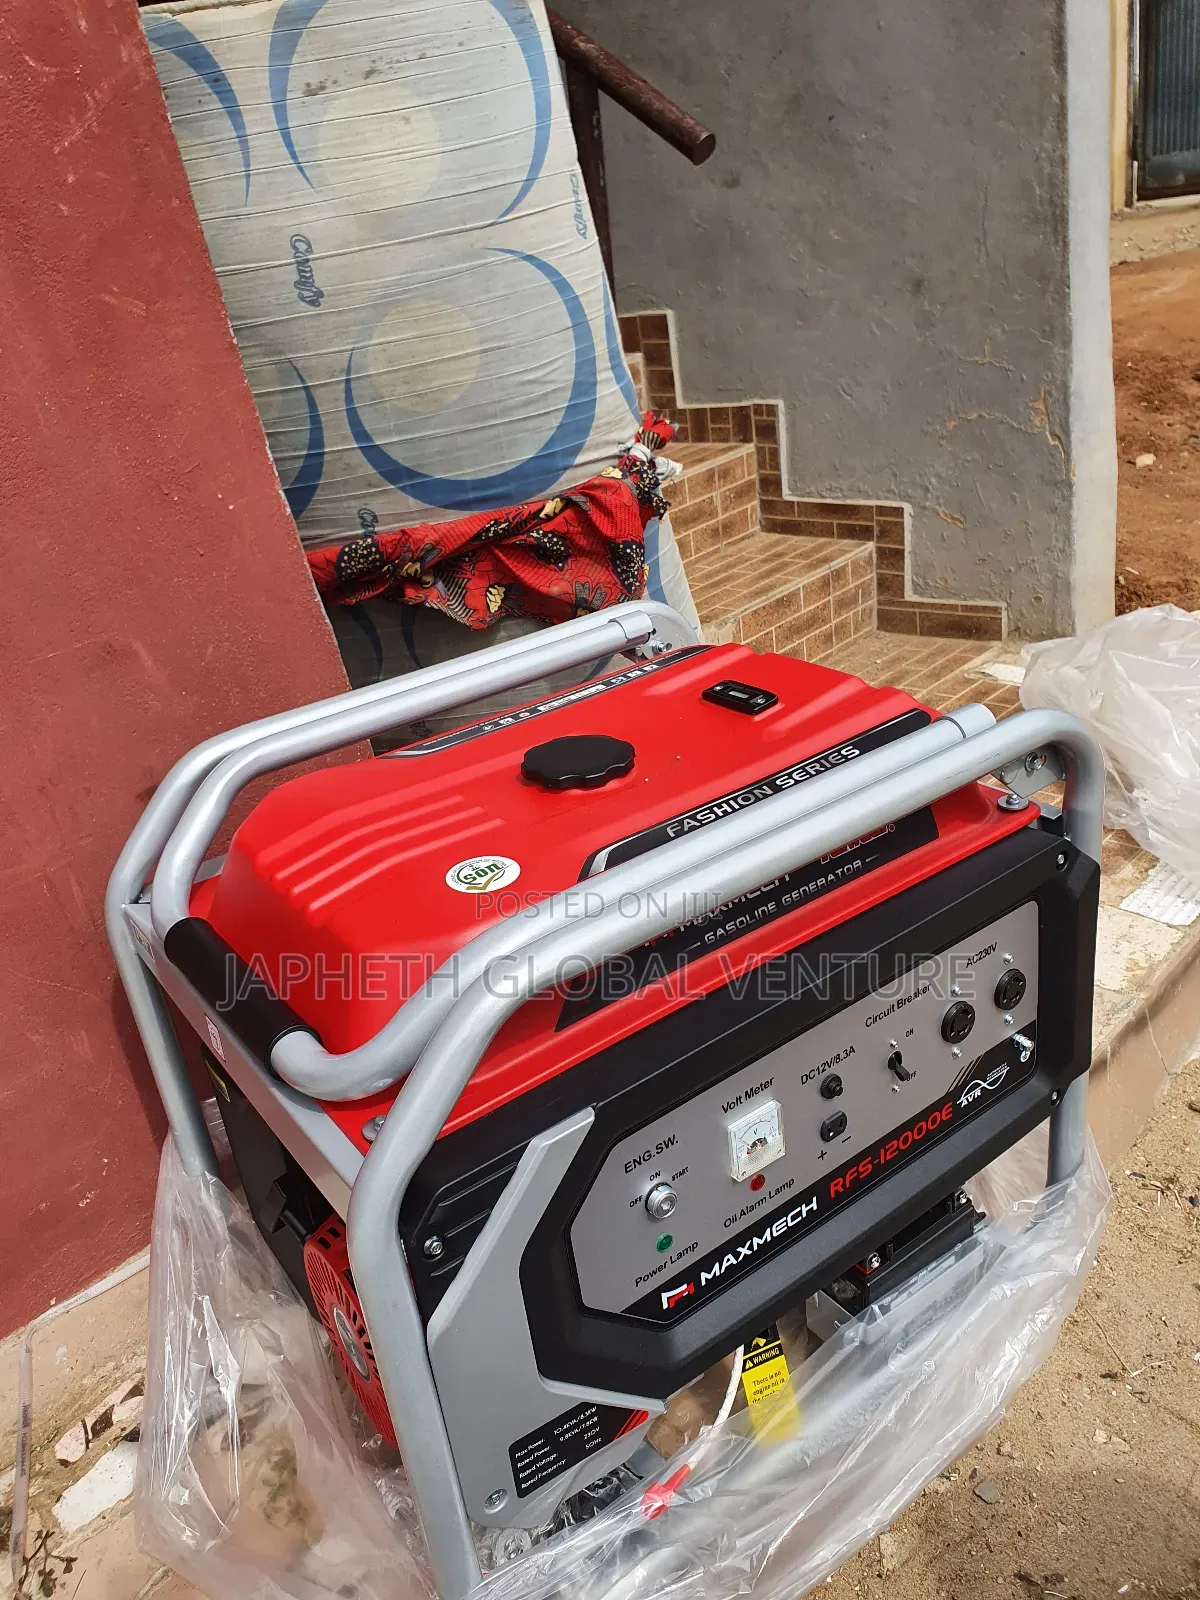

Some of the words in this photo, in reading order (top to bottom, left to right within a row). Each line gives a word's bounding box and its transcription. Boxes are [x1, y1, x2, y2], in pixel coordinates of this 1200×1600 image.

[290, 233, 325, 307] Comfy
[666, 785, 774, 838] FASHION
[775, 745, 860, 790] SERIES
[704, 901, 777, 945] GASOLINE
[781, 859, 862, 906] GENERATOR
[966, 942, 998, 968] AC230V
[865, 1004, 896, 1028] Circuit
[897, 983, 932, 1010] Breaker
[905, 1028, 914, 1038] ON
[801, 1045, 856, 1085] DC12V/8.3A
[721, 1096, 743, 1114] Volt
[744, 1077, 775, 1101] Meter
[960, 1089, 981, 1108] AVR
[624, 1134, 679, 1174] ENG.SW.
[830, 1102, 953, 1198] RFS-12000E
[649, 1170, 661, 1182] ON
[671, 1166, 689, 1182] START
[629, 1195, 643, 1208] OFF
[723, 1214, 737, 1229] Oil
[739, 1196, 767, 1220] Alarm
[768, 1178, 795, 1200] Lamp
[700, 1196, 818, 1287] MAXMECH
[635, 1261, 668, 1287] Power
[670, 1241, 699, 1265] Lamp
[752, 1347, 780, 1365] WARNING
